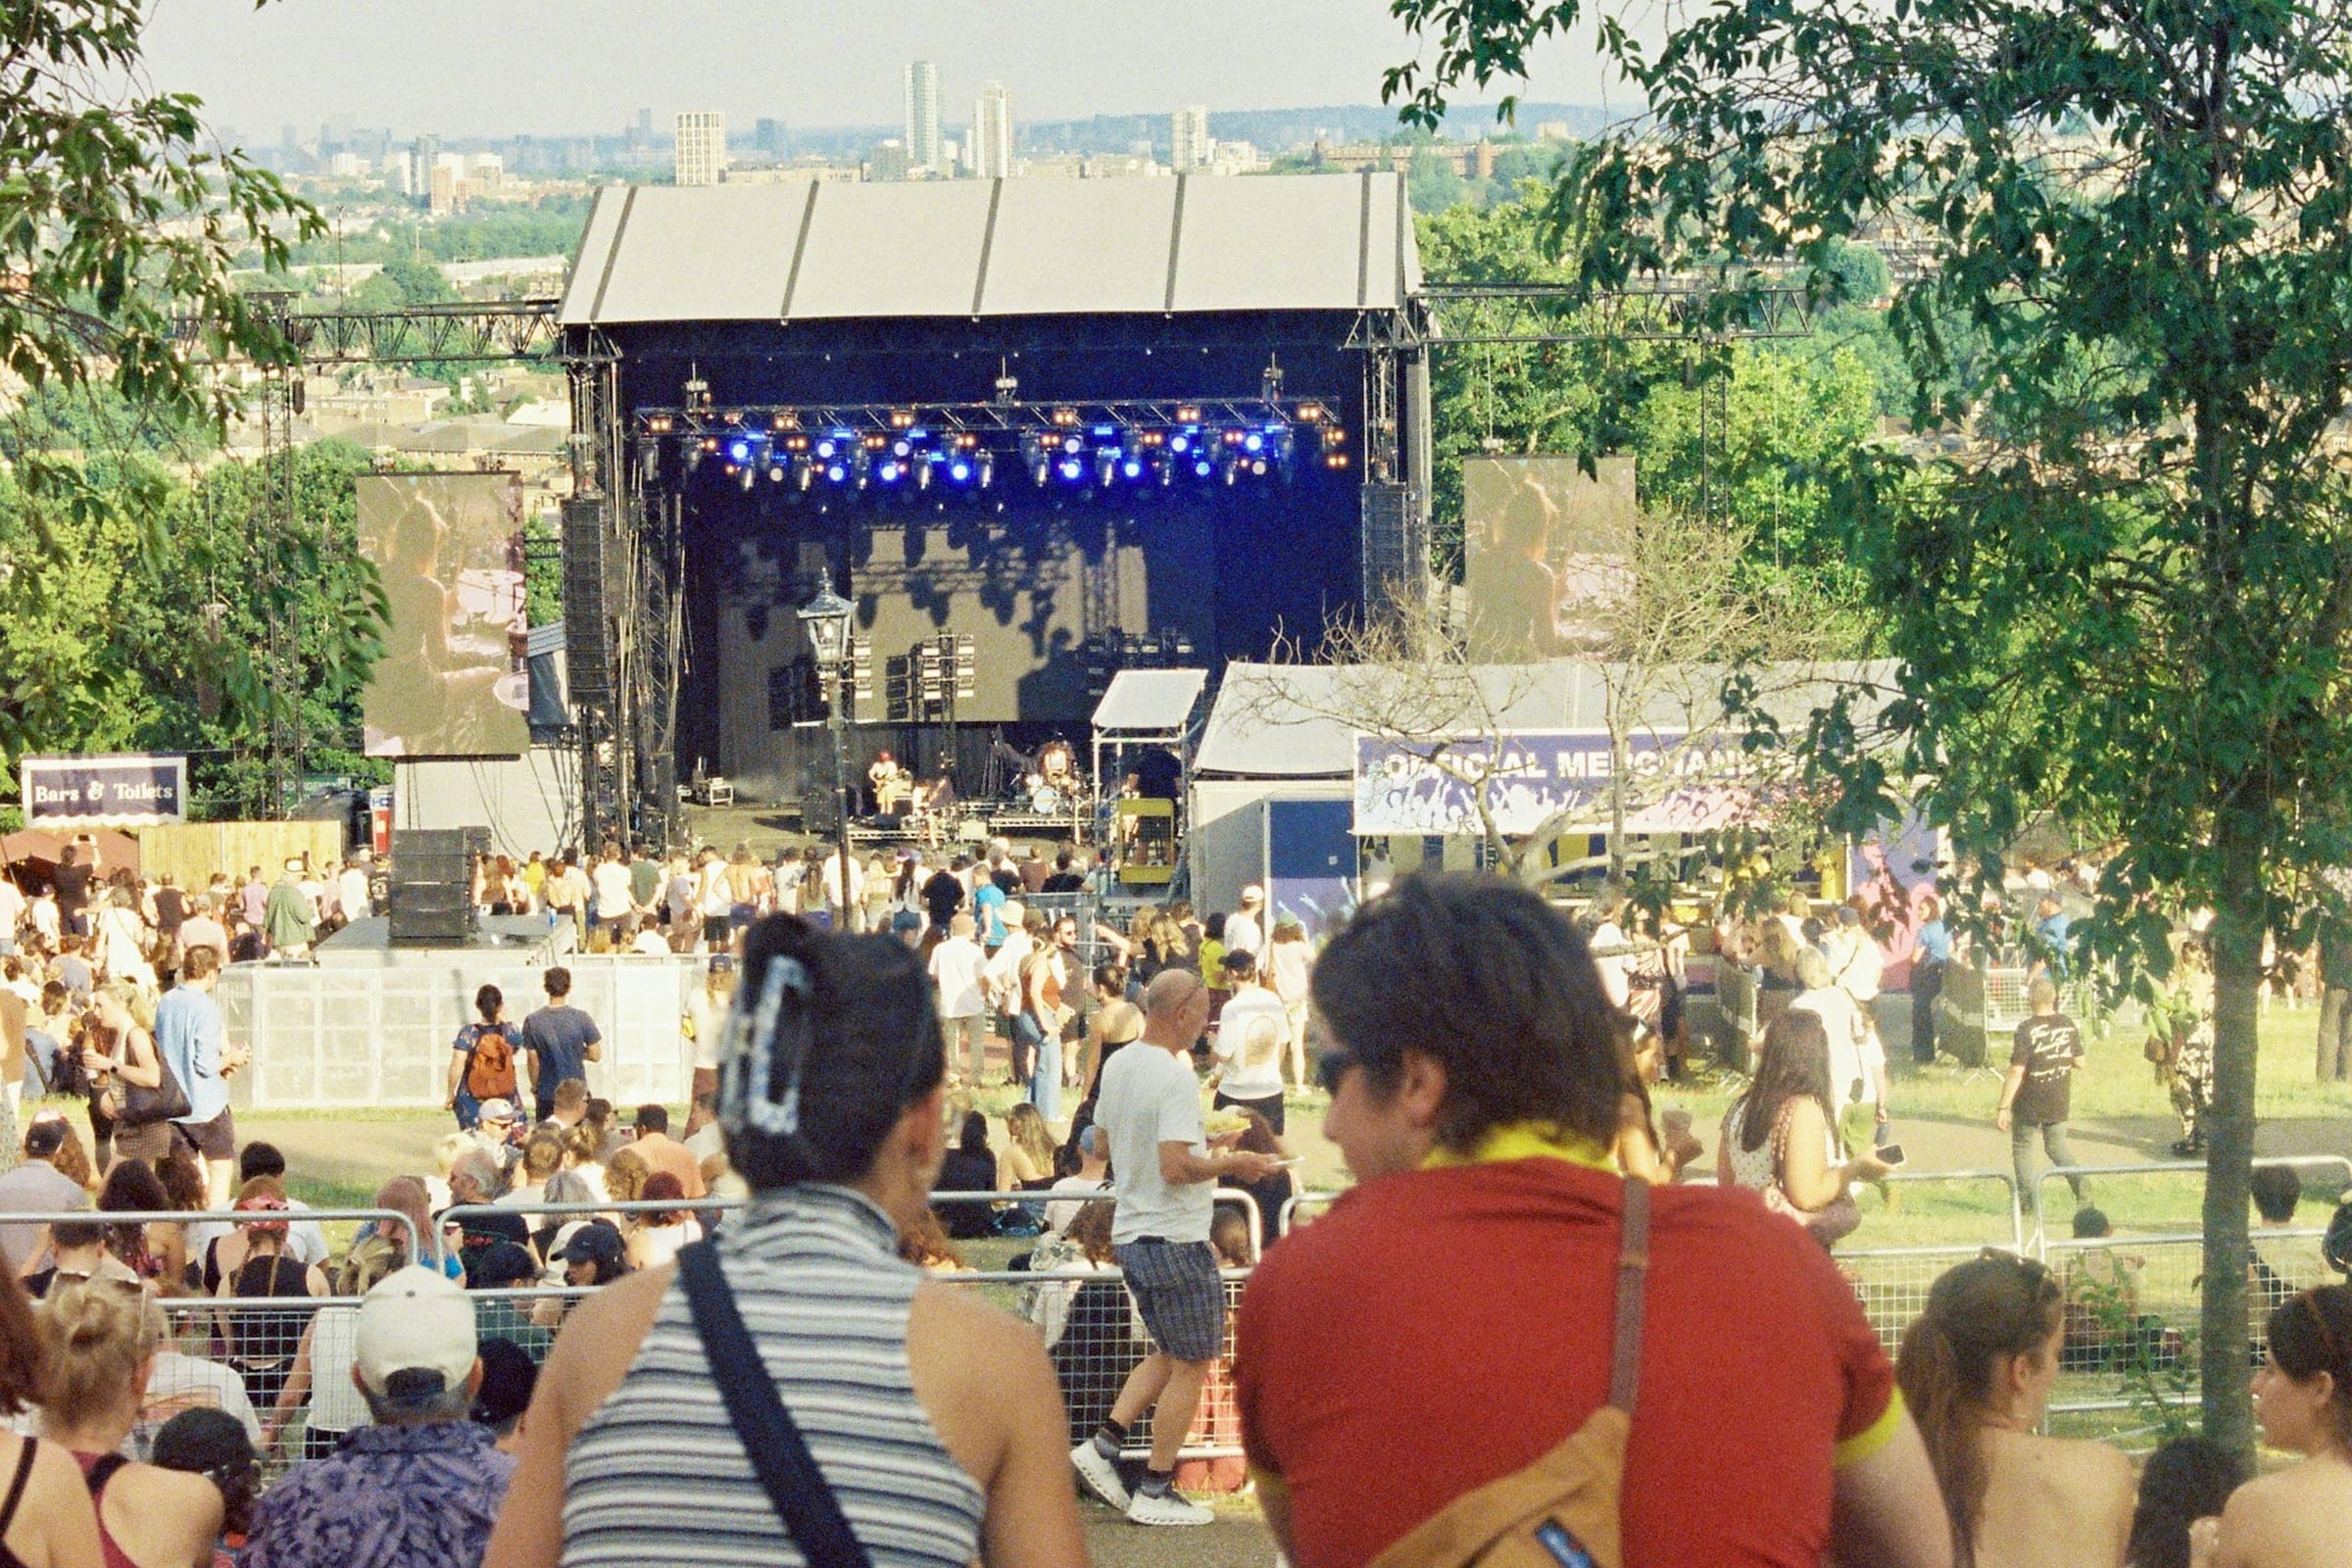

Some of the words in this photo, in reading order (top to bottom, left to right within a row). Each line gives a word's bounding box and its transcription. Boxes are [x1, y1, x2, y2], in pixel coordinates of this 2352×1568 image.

[34, 785, 80, 803] Bars
[86, 780, 104, 802] &
[113, 782, 173, 801] Toilets
